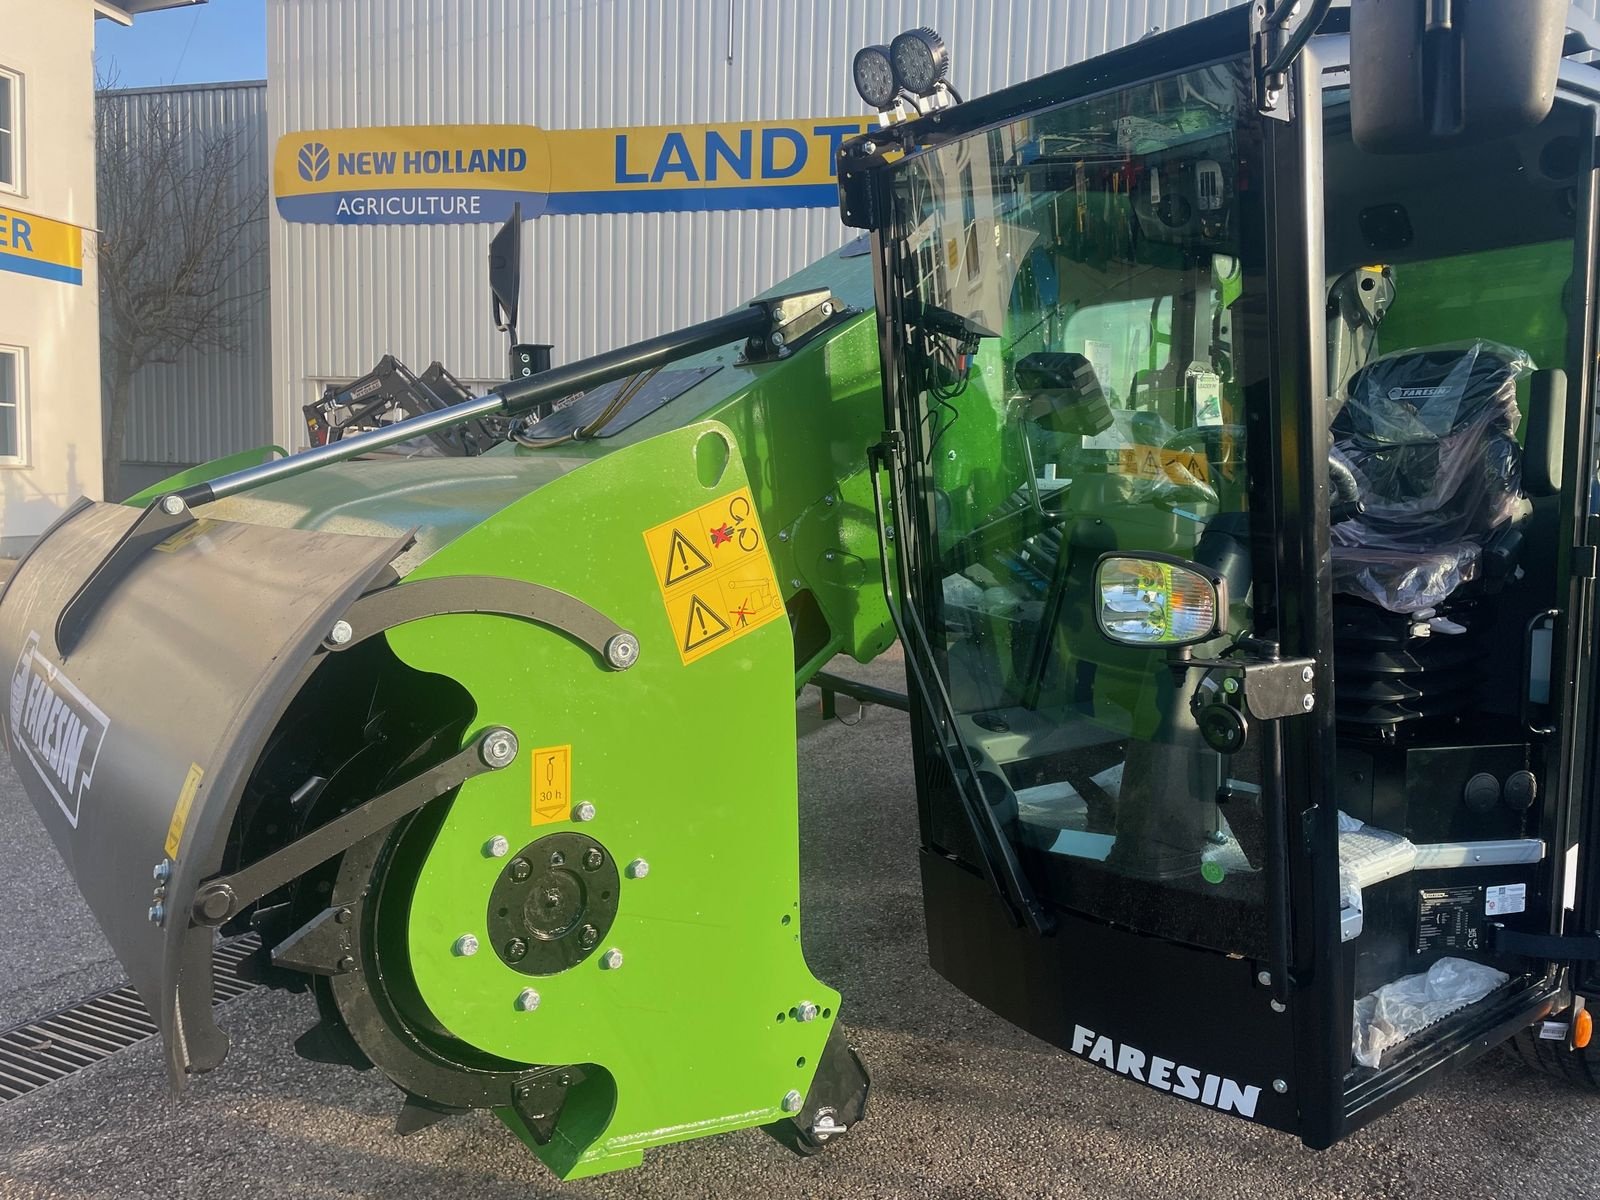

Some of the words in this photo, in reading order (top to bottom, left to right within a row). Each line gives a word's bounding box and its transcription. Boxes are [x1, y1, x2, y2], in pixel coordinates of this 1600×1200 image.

[338, 152, 396, 175] NEW
[404, 148, 527, 174] HOLLAND
[615, 124, 882, 183] LANDT
[336, 196, 480, 215] AGRICULTURE
[1402, 387, 1446, 397] FARESIN
[24, 673, 89, 795] FARESIN
[540, 791, 552, 802] 30
[555, 789, 562, 800] h
[1070, 1024, 1263, 1118] FARESIN
